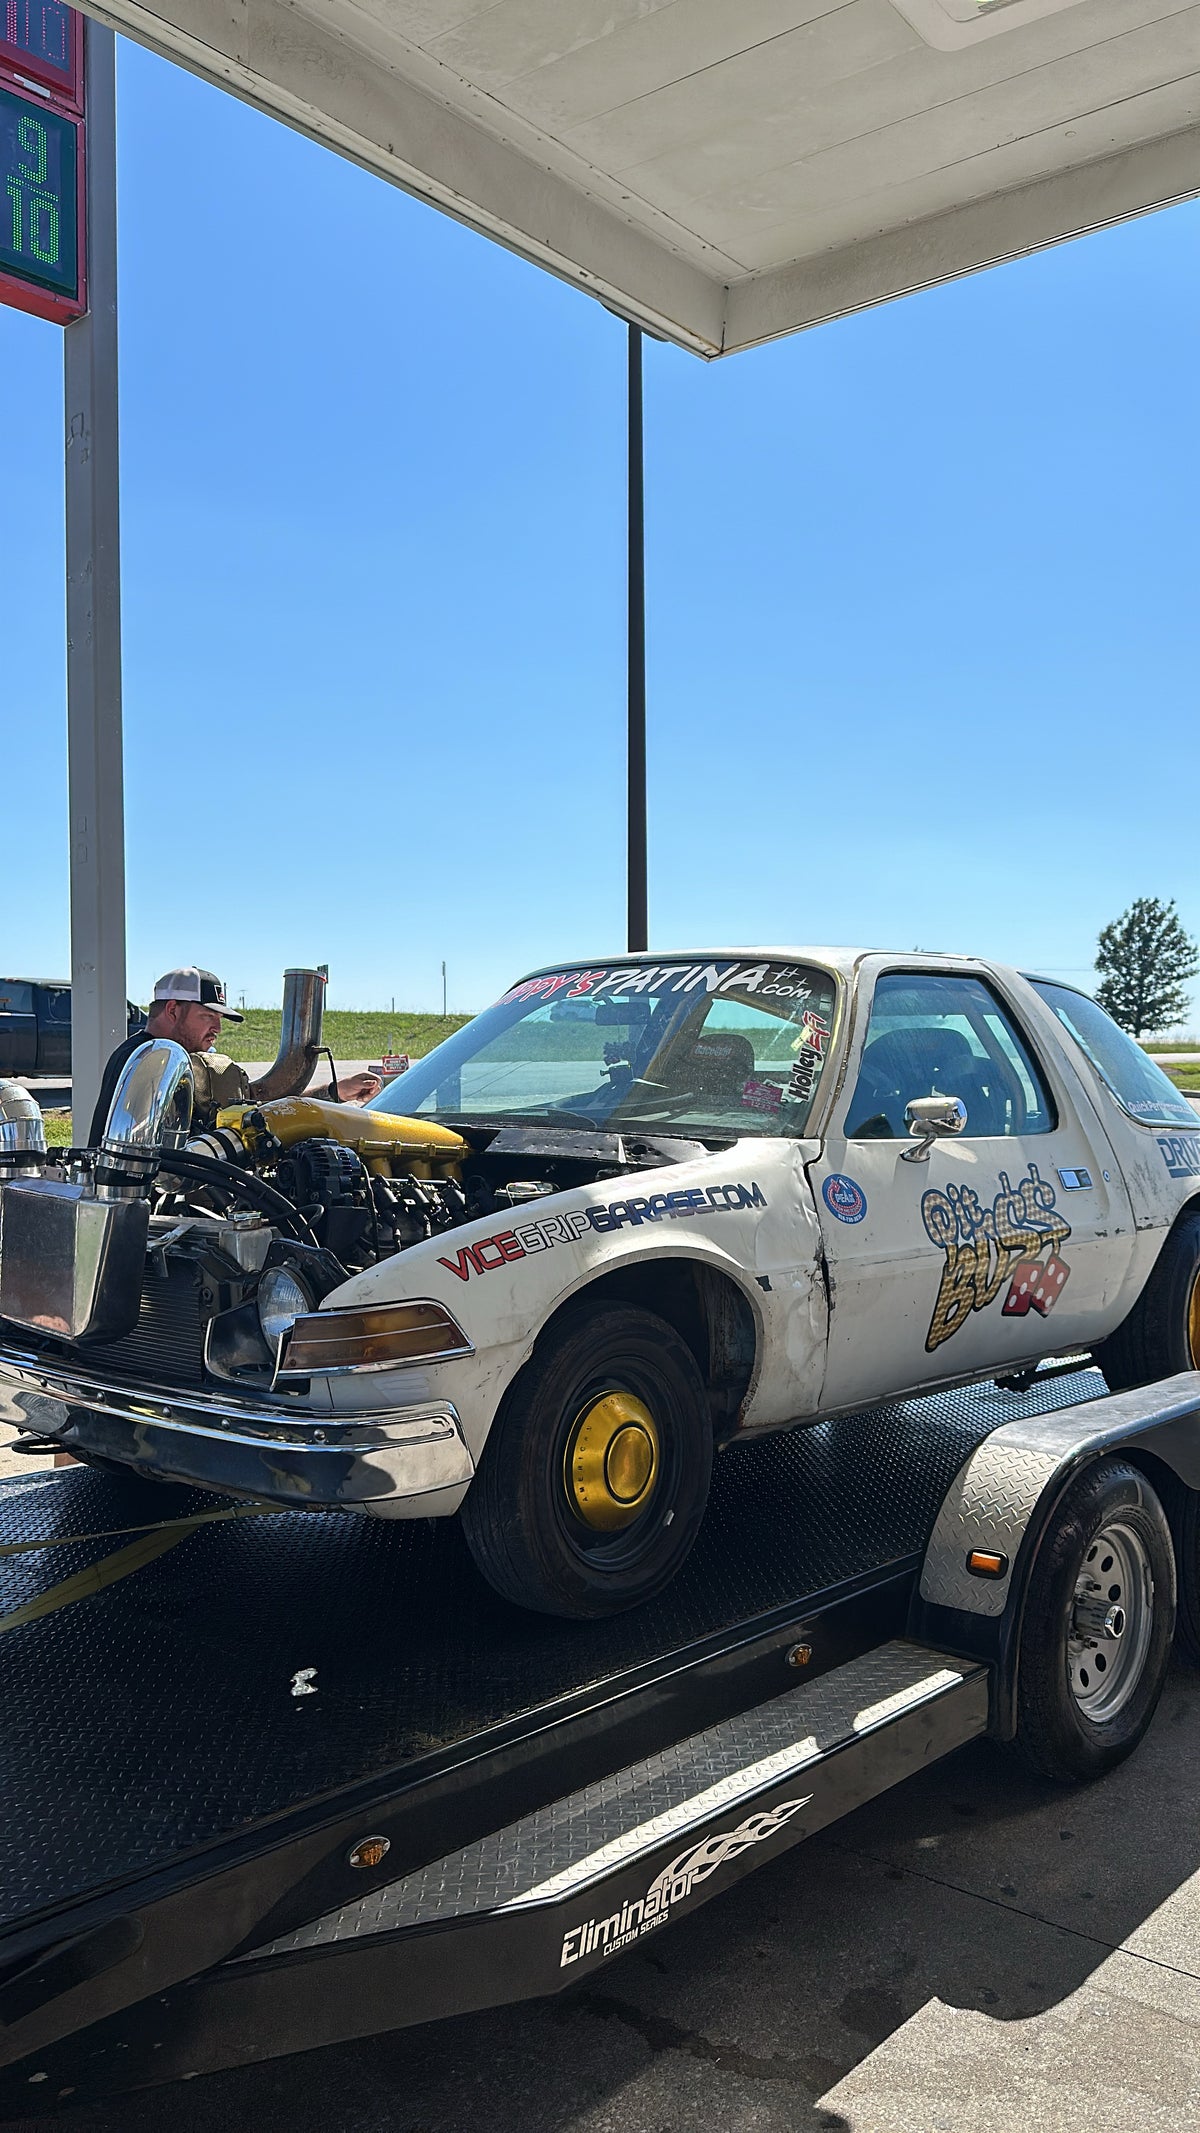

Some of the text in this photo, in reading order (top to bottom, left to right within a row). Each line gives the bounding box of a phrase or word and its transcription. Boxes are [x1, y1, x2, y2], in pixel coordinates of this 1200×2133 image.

[18, 116, 48, 185] 9
[7, 184, 60, 265] 10
[788, 1046, 823, 1101] Holley
[559, 1867, 700, 1968] Eliminator
[603, 1909, 669, 1957] CUSTOM SERIES
